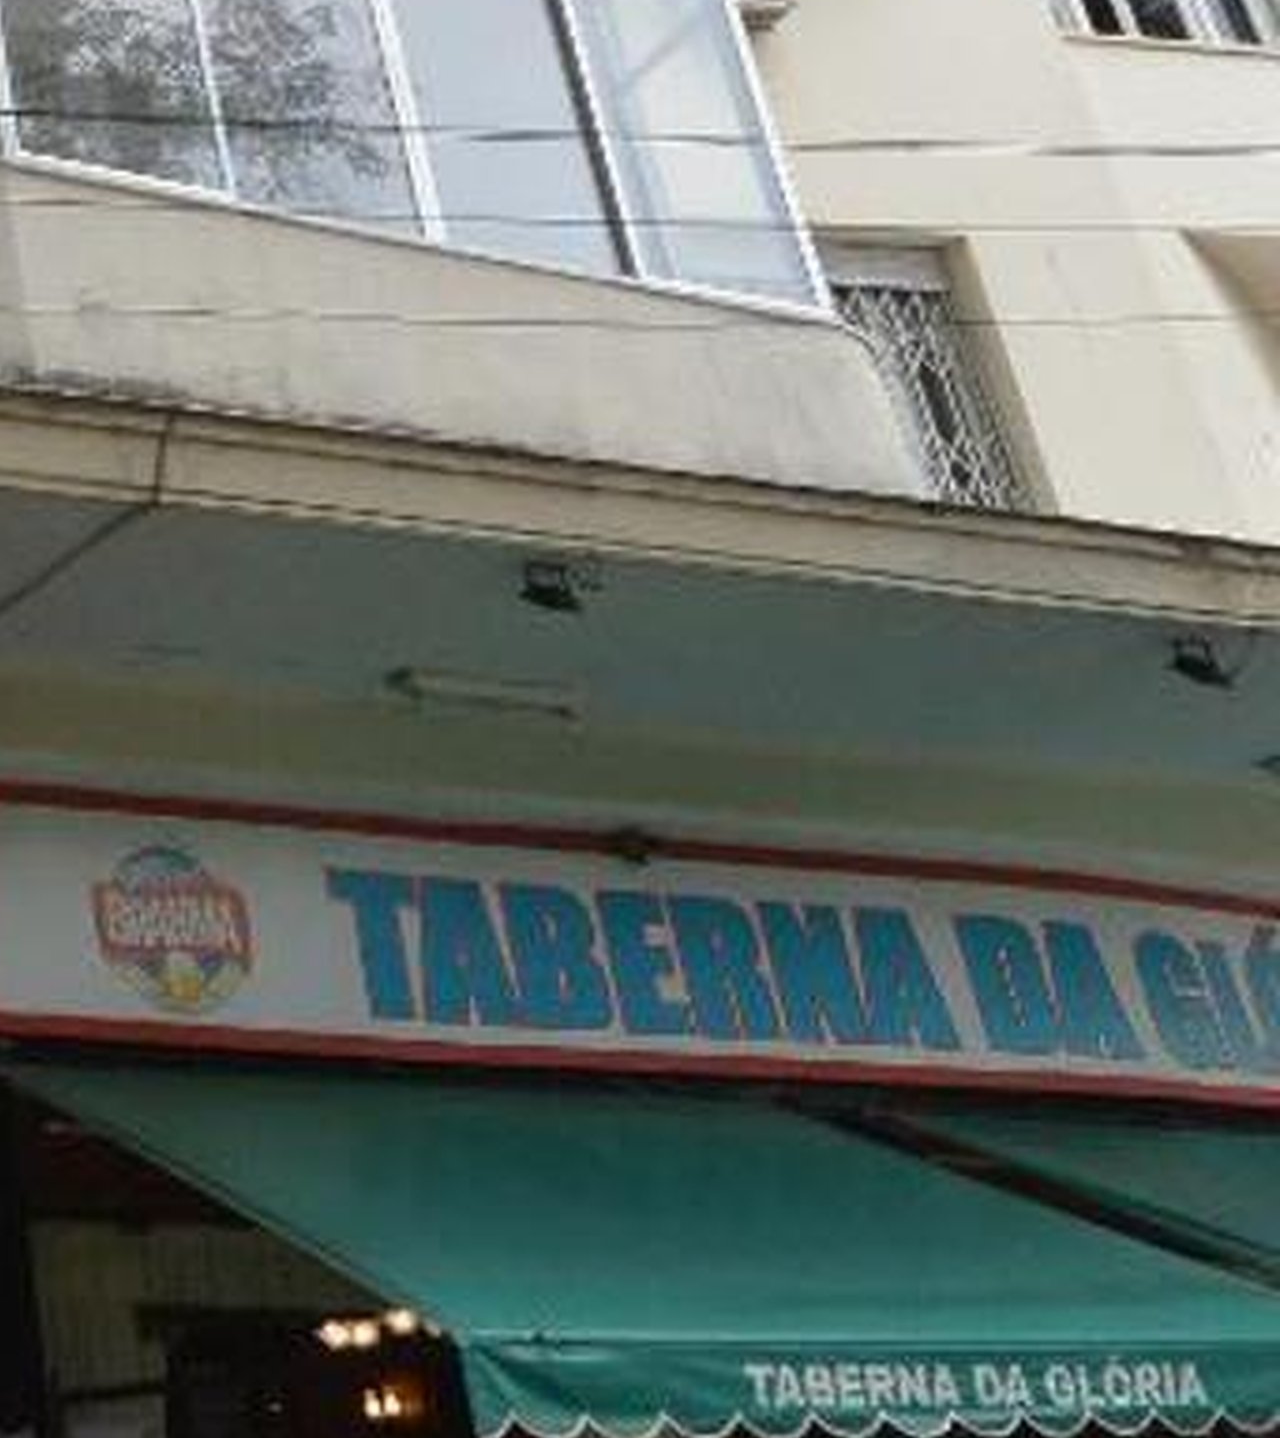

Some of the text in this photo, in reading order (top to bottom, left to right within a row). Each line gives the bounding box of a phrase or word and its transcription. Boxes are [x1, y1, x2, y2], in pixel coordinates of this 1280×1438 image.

[326, 868, 956, 1047] TABERNA
[954, 914, 1143, 1061] DA
[744, 1362, 963, 1409] TABERNA
[973, 1363, 1034, 1409] DA
